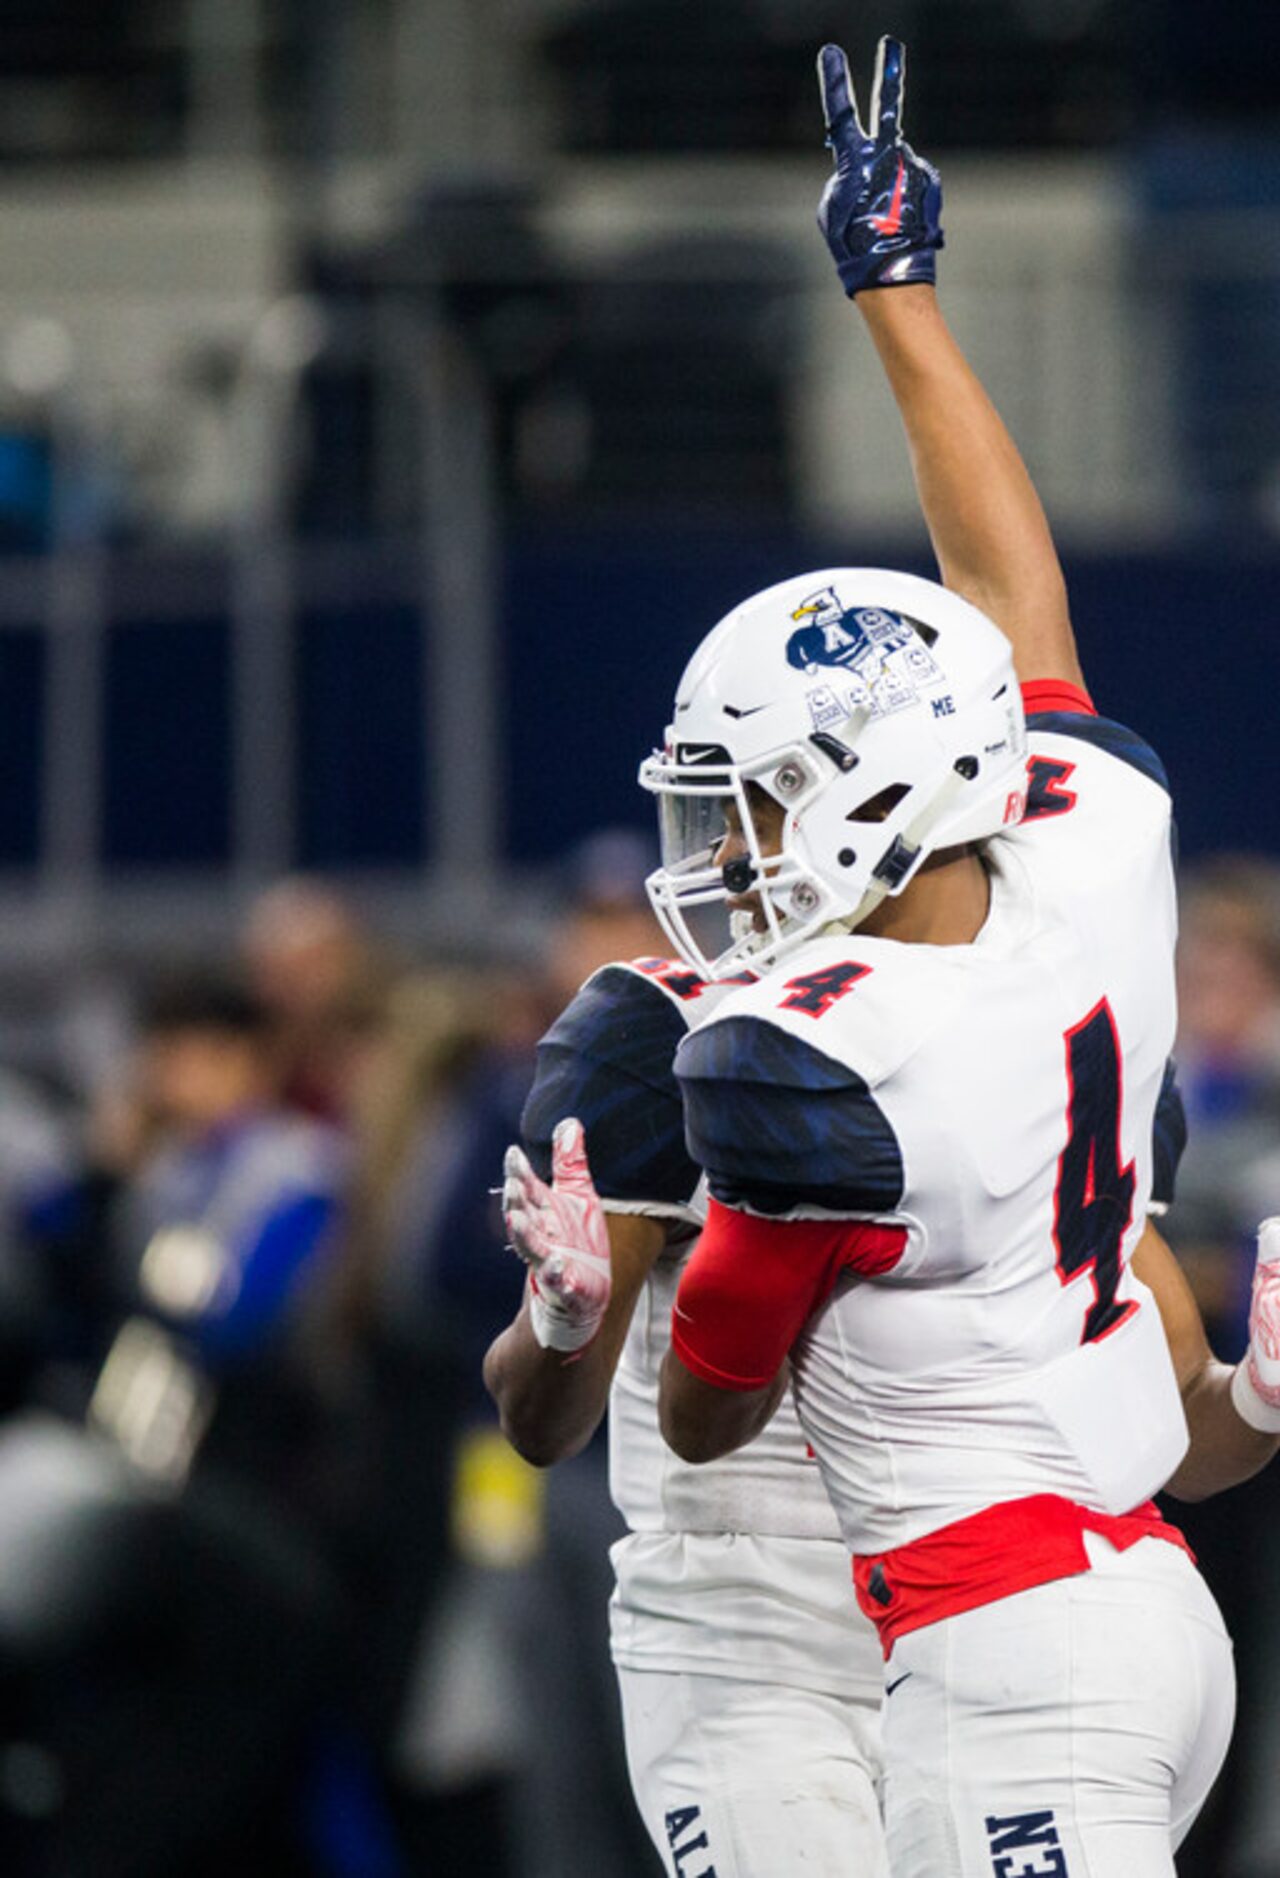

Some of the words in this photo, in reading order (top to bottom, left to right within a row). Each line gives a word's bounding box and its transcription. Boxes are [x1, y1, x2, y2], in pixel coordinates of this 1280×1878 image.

[930, 695, 956, 718] ME
[777, 960, 873, 1019] 4
[1052, 995, 1141, 1346] 4
[665, 1805, 718, 1878] AL
